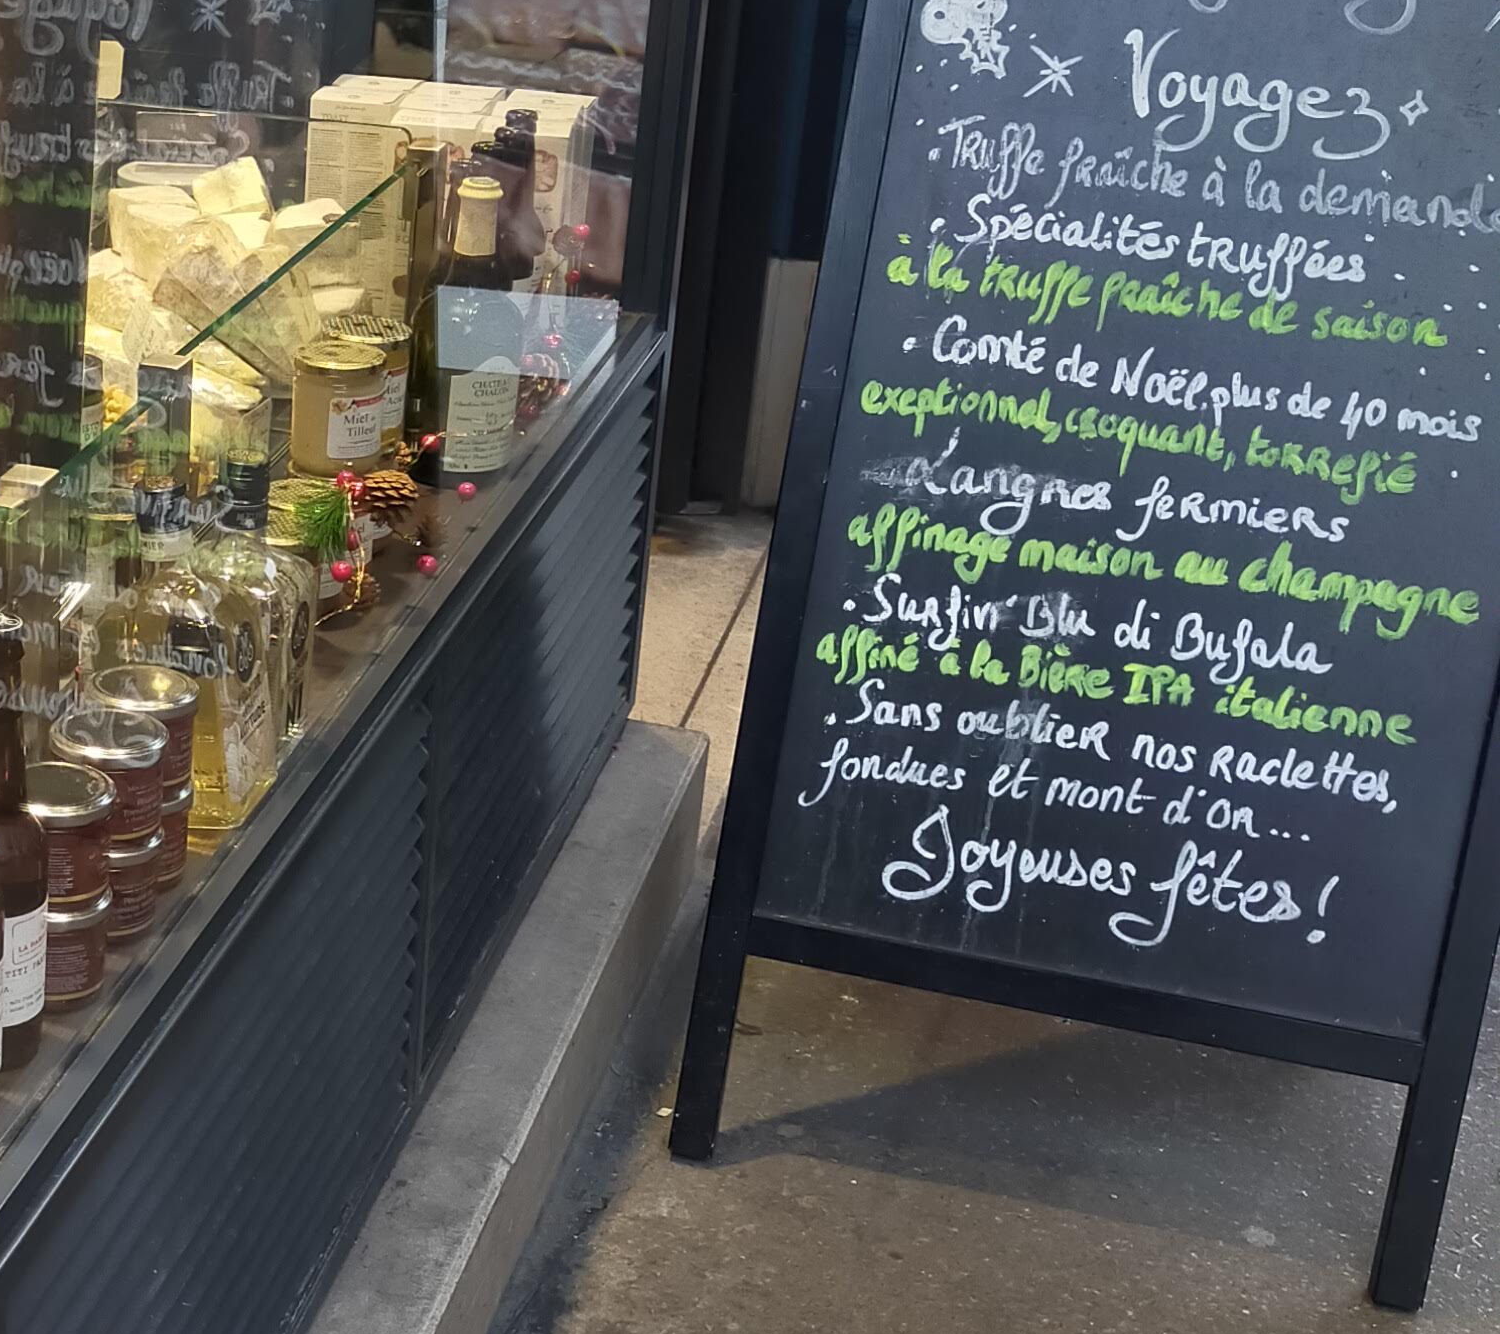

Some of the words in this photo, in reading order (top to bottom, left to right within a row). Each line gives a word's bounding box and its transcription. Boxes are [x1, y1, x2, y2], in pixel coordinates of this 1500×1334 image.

[1123, 27, 1390, 160] Voyagez
[1201, 155, 1226, 207] à
[1245, 158, 1283, 214] la
[927, 240, 970, 295] la
[1247, 287, 1300, 337] de
[1310, 299, 1449, 348] saison
[343, 413, 369, 426] Miel
[932, 315, 1045, 376] Comté
[1056, 342, 1099, 388] de
[1285, 381, 1331, 423] de
[1339, 390, 1388, 442] 40
[1396, 402, 1484, 444] mois
[1017, 537, 1164, 583] maison
[1173, 548, 1230, 587] au
[1236, 541, 1481, 642] champagne
[1112, 598, 1160, 652] di
[843, 678, 943, 731] Sans
[1130, 734, 1197, 775] nos
[969, 638, 1012, 689] la
[1121, 659, 1196, 709] IPA
[1212, 680, 1418, 747] italienne
[798, 738, 967, 808] fondues
[986, 755, 1041, 801] et
[1043, 772, 1157, 818] mont
[881, 803, 1137, 914] Joyeuses
[4, 964, 29, 980] TITI
